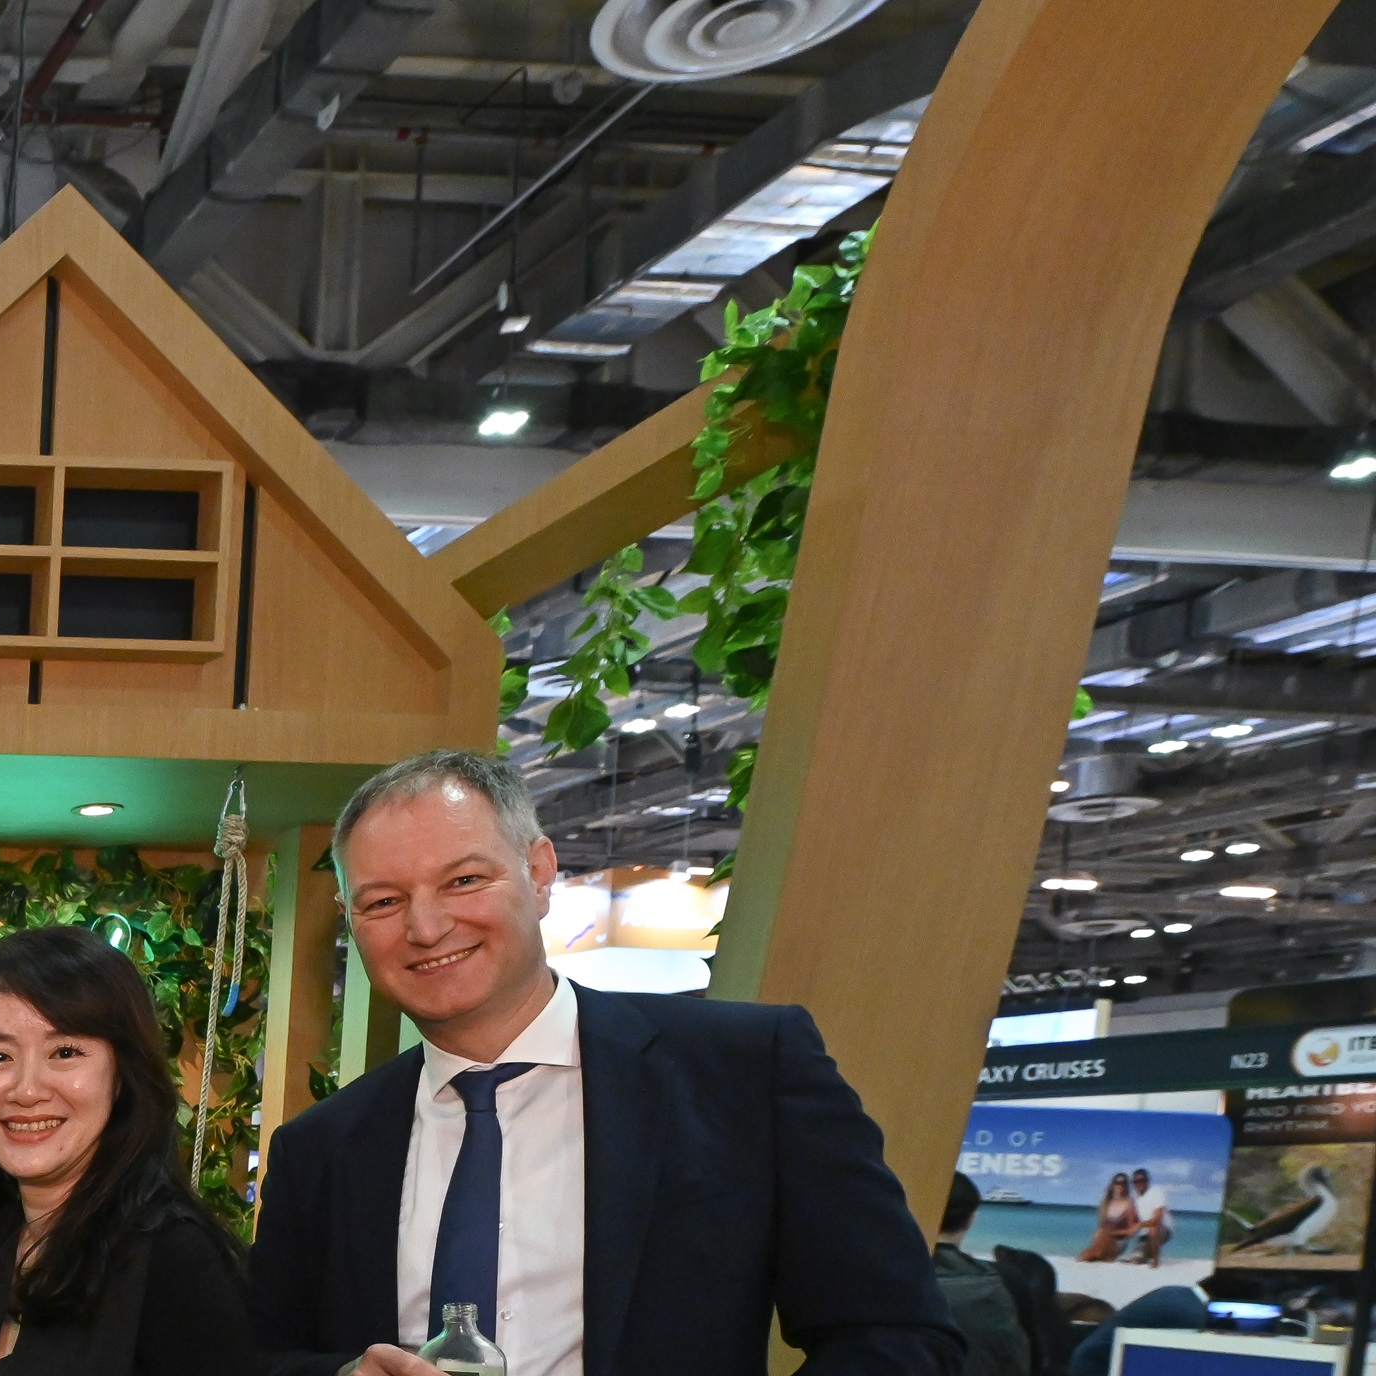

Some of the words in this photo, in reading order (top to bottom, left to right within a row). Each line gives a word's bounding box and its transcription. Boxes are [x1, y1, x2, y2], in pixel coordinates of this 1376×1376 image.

[979, 1064, 1020, 1084] AXY
[1021, 1058, 1108, 1082] CRUISES
[1229, 1052, 1269, 1070] N23
[1008, 1130, 1045, 1147] OF
[956, 1152, 1063, 1177] ENESS
